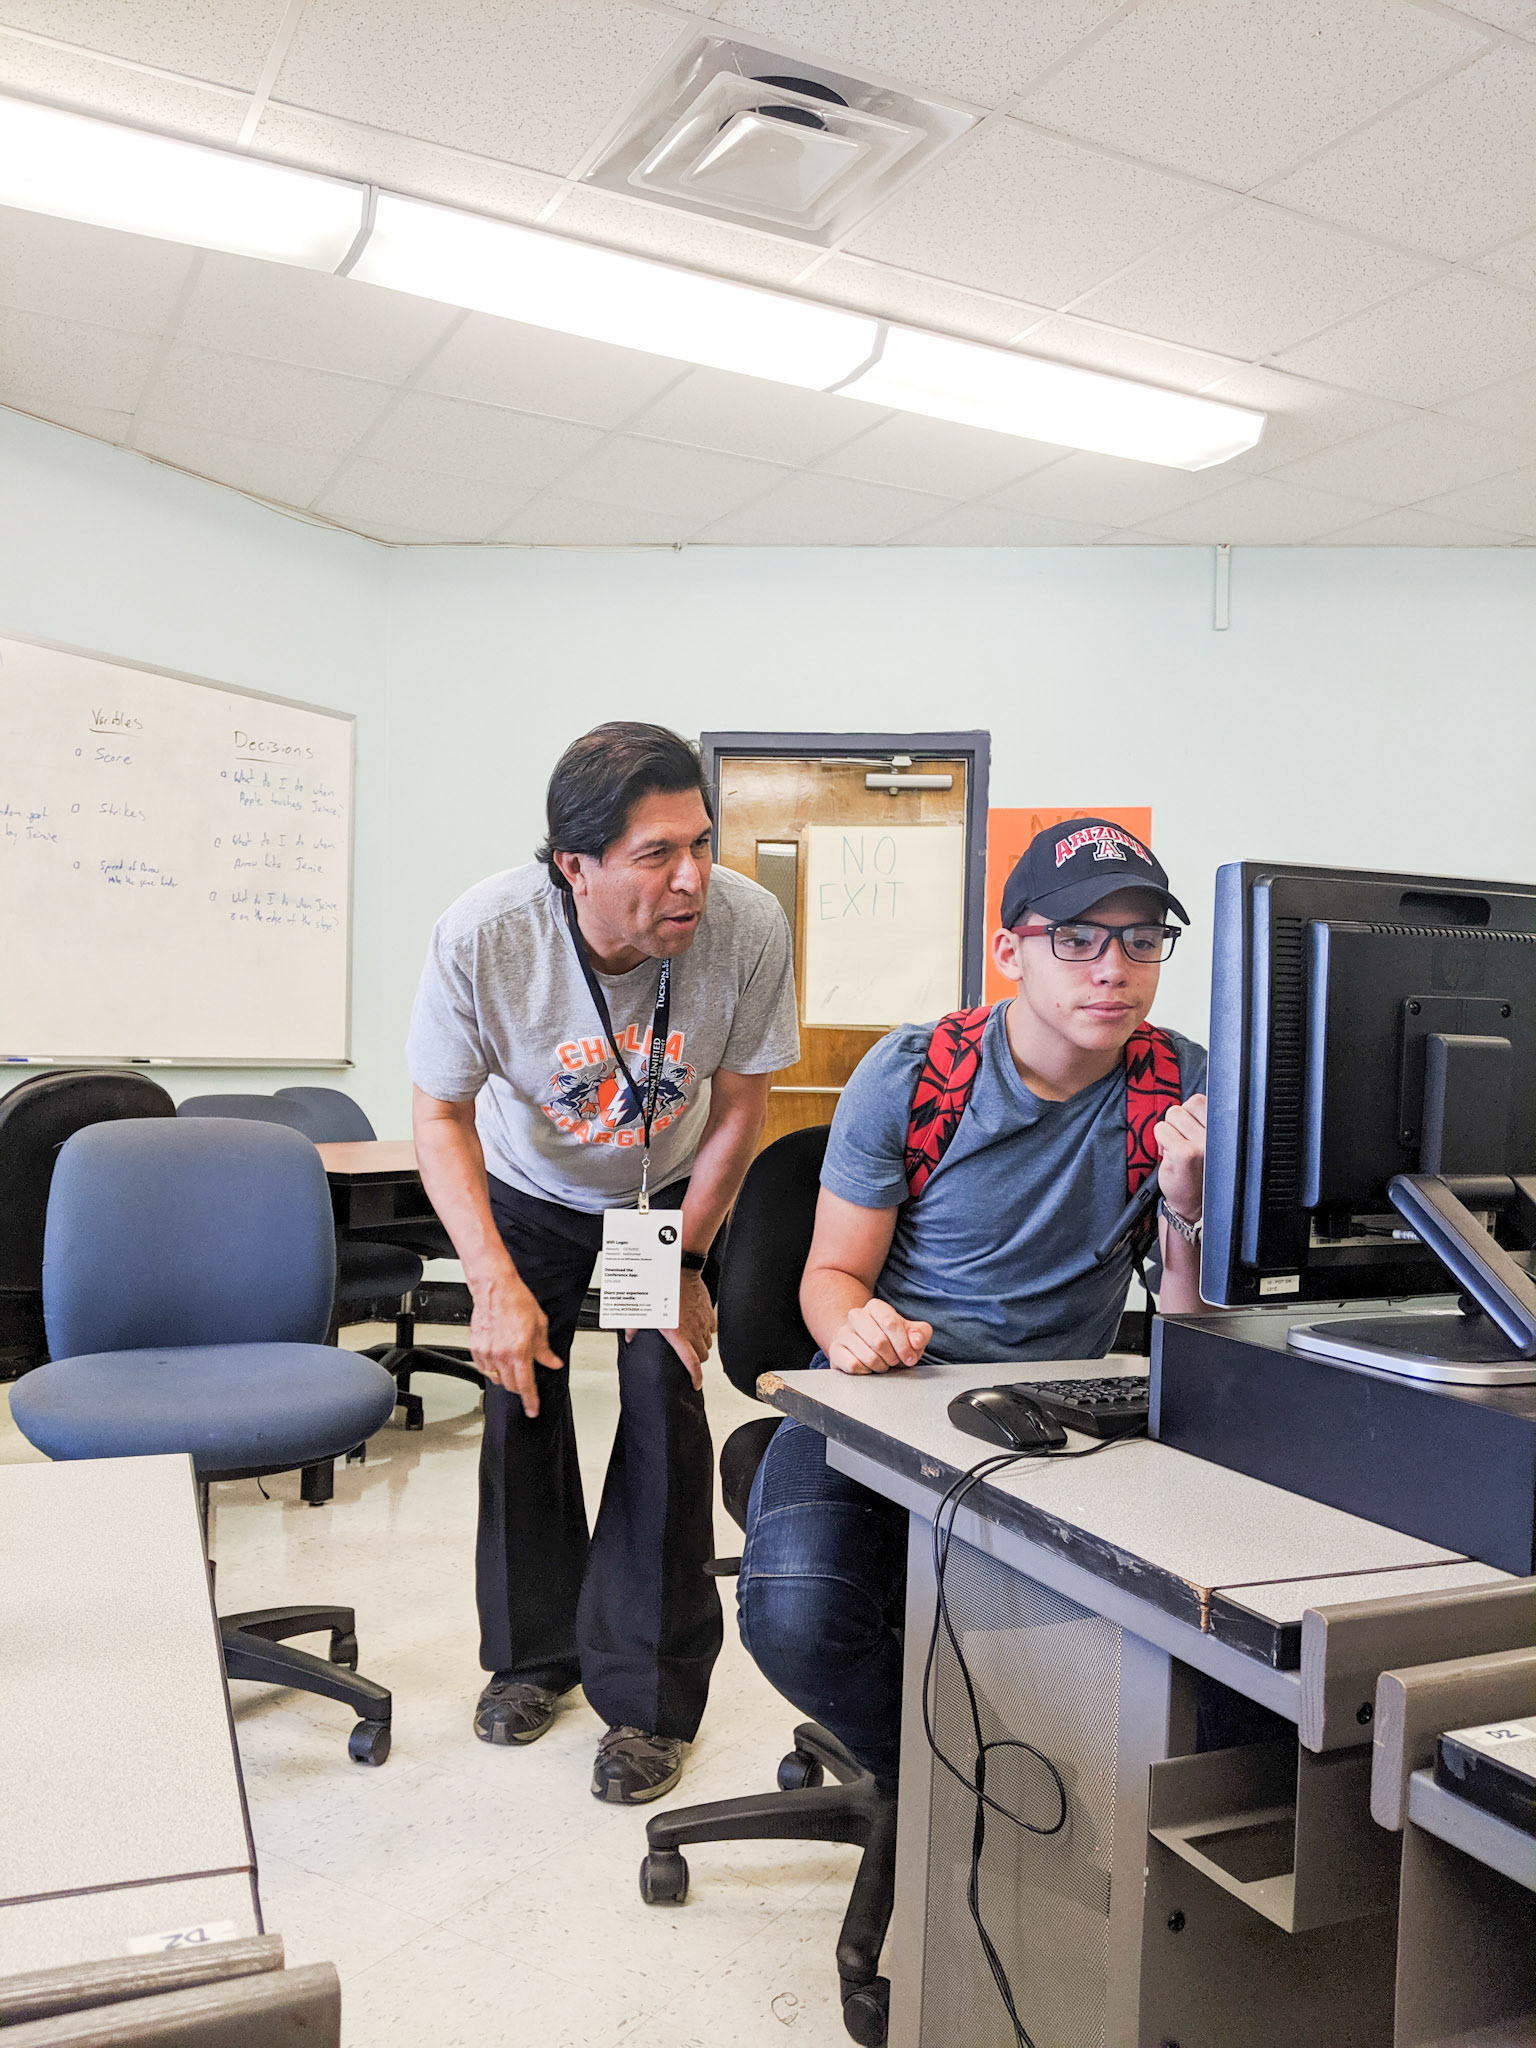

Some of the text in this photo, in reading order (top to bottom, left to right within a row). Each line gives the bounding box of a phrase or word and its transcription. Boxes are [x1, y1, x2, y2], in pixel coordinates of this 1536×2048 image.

[94, 747, 133, 765] Score
[234, 730, 315, 760] Decisions
[278, 777, 288, 790] I
[98, 802, 147, 822] Strikes
[239, 791, 263, 807] Apple
[279, 834, 288, 847] I
[1055, 825, 1153, 869] ARIZONA
[1092, 838, 1128, 862] A
[842, 835, 897, 876] NO
[266, 892, 277, 906] I
[819, 880, 905, 921] EXIT
[656, 971, 666, 1010] TUCSON
[555, 1022, 686, 1073] CHOLLA
[647, 1037, 661, 1116] TUCSON UNIFIED
